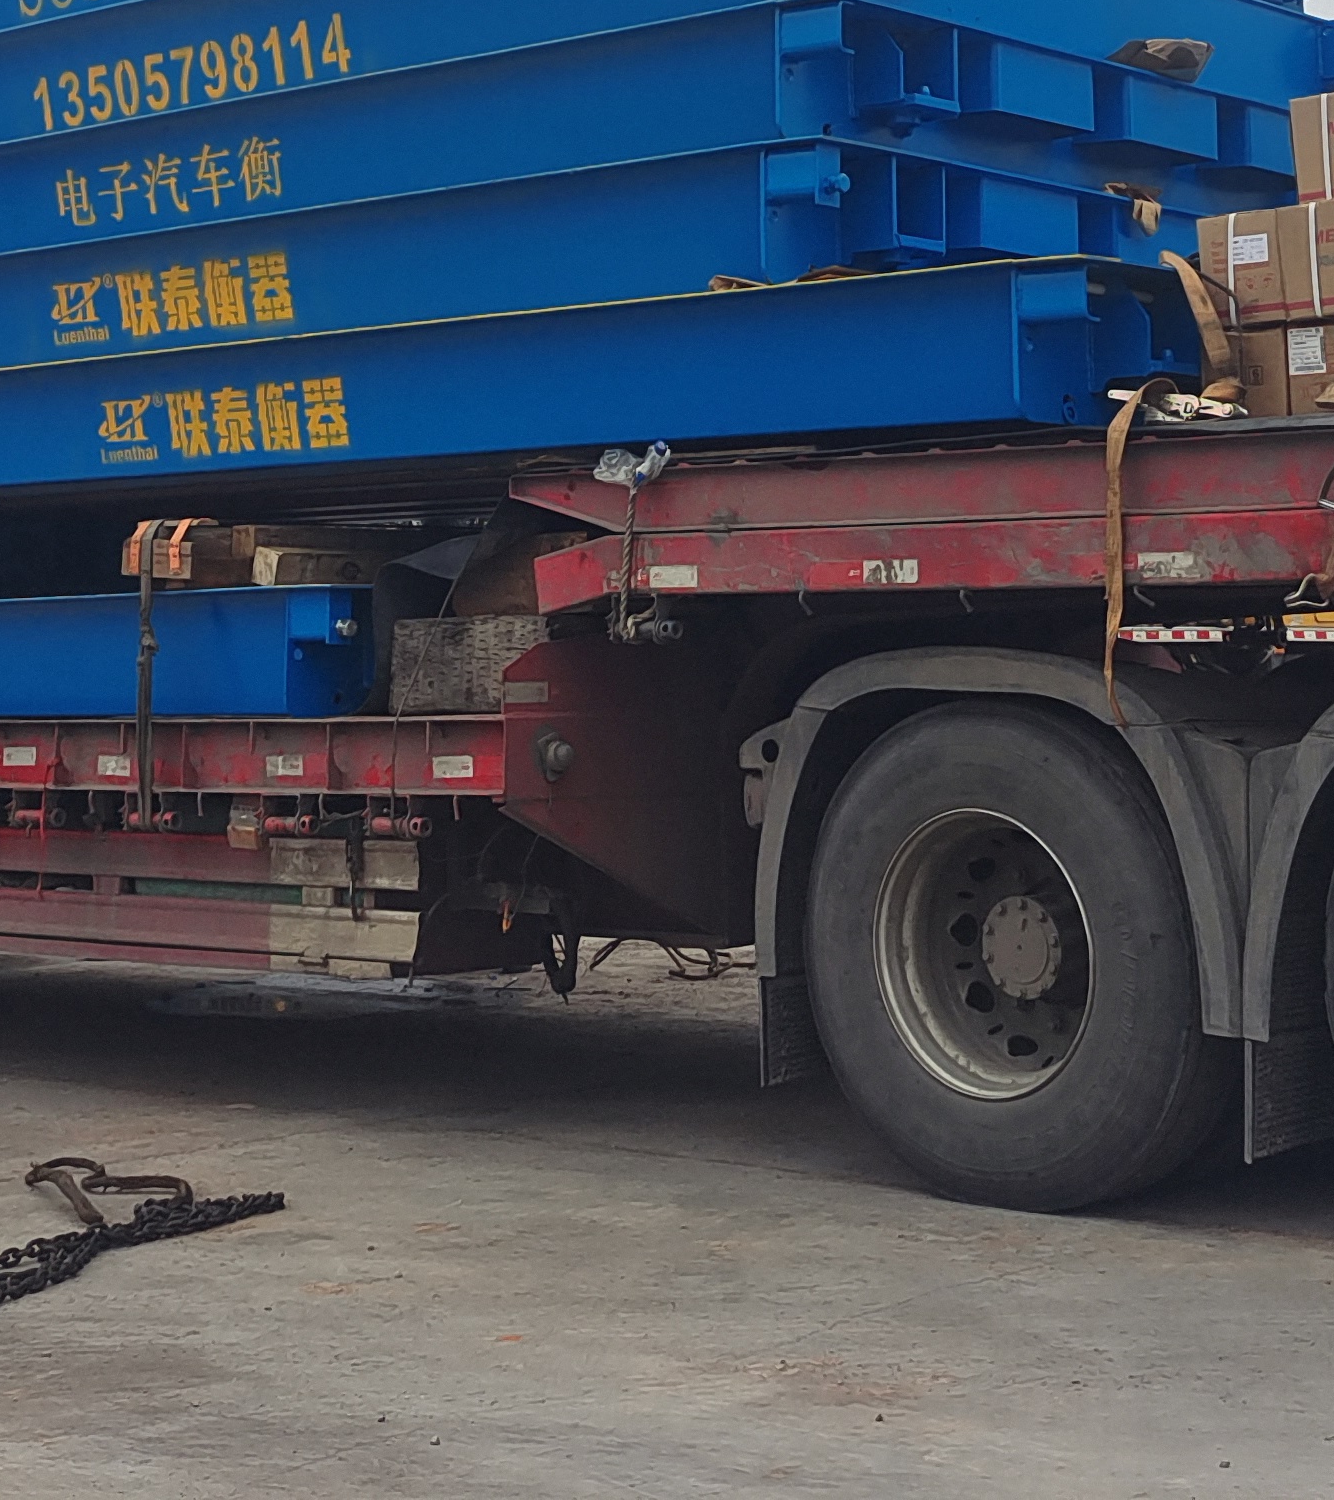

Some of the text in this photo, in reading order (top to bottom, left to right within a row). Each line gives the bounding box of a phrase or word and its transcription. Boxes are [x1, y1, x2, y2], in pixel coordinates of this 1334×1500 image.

[34, 12, 352, 131] 13505798114
[55, 135, 283, 227] 电子汽车衡
[115, 251, 294, 337] 联泰衡器
[164, 376, 350, 458] 联泰衡器
